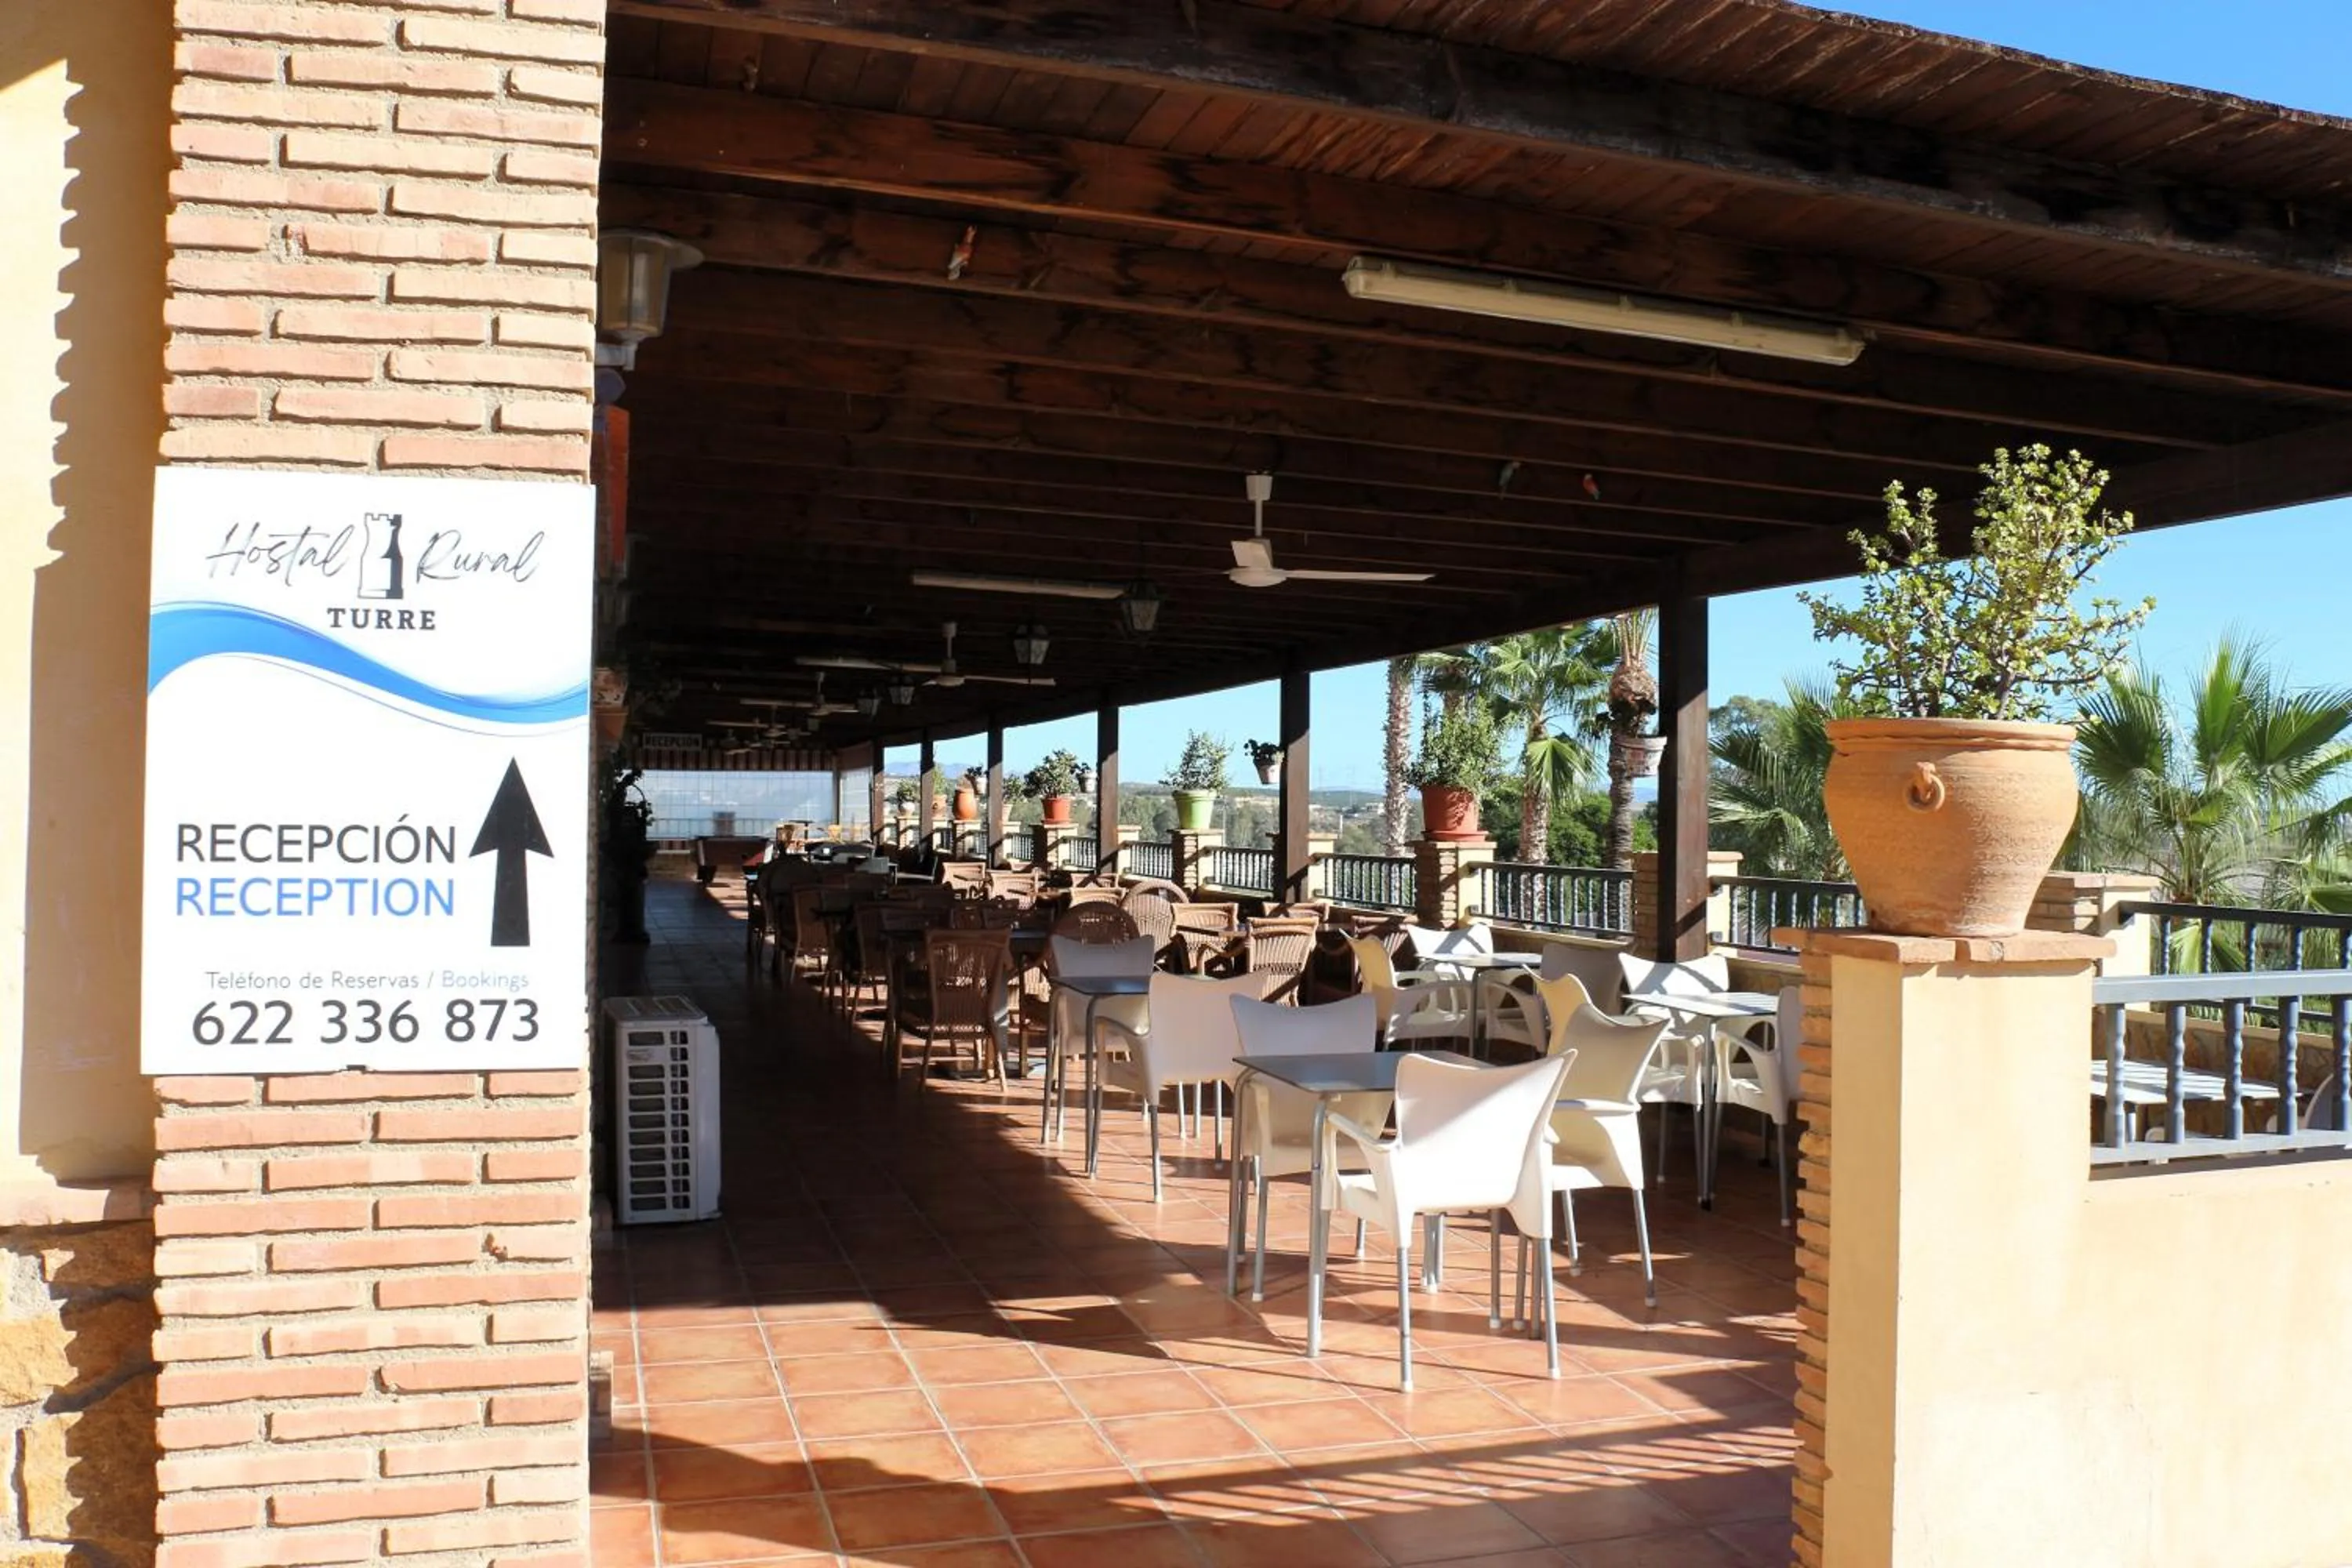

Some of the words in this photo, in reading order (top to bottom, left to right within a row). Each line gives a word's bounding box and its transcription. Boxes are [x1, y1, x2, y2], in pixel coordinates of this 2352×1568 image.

[205, 522, 354, 586] Hostal
[416, 530, 544, 584] Rural
[327, 608, 436, 630] TURRE
[176, 813, 456, 865] RECEPCIÓN
[176, 877, 454, 917] RECEPTION
[205, 971, 291, 989] Teléfono
[299, 972, 324, 989] de
[332, 971, 419, 989] Reservas
[442, 970, 529, 993] Bookings
[192, 1000, 293, 1046] 622
[320, 999, 419, 1045] 336
[445, 998, 539, 1043] 873
